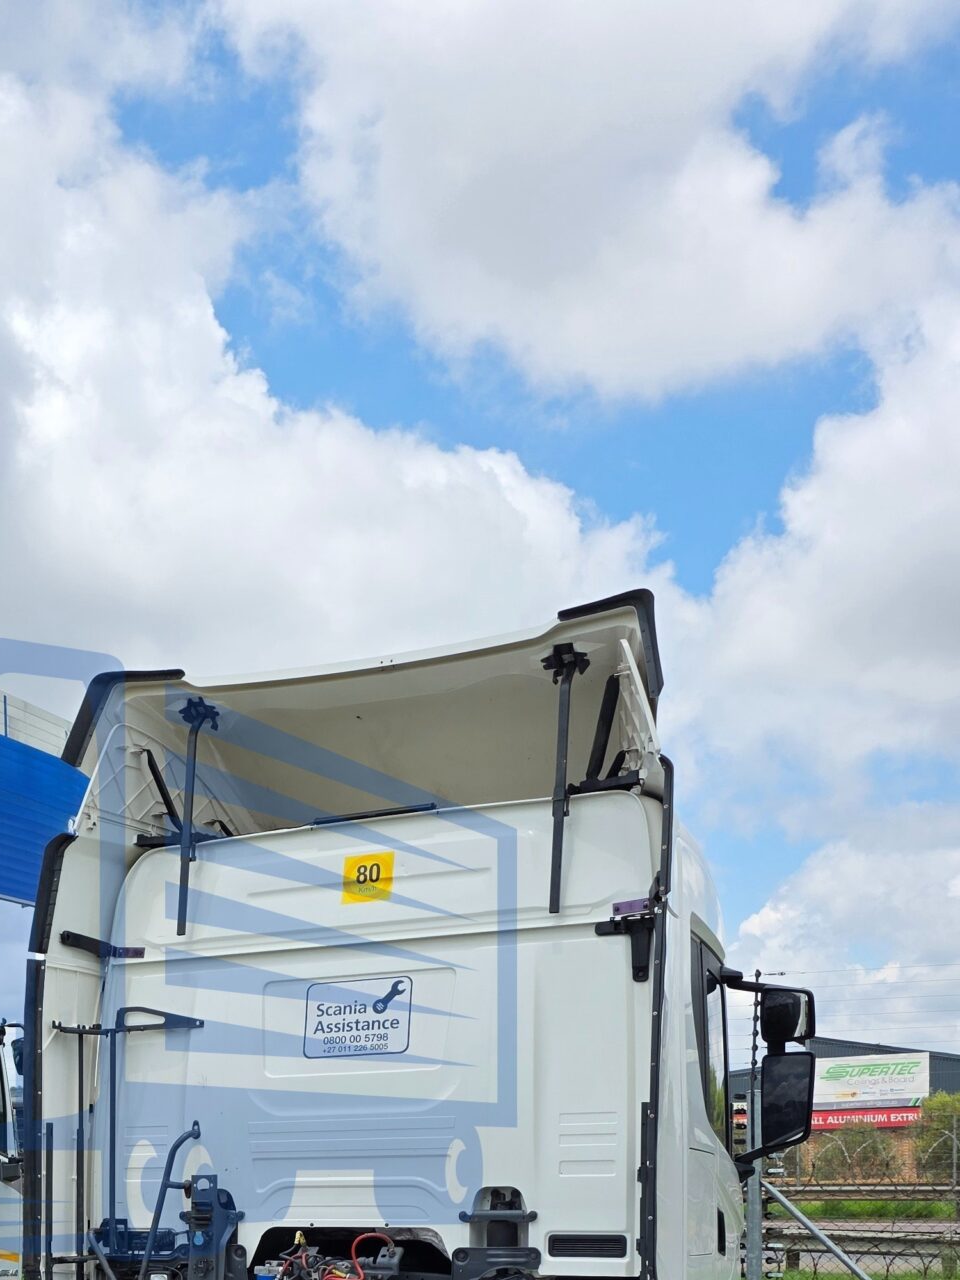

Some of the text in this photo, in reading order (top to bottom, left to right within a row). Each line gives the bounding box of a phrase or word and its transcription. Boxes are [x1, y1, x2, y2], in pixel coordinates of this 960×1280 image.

[356, 862, 380, 885] 80
[316, 1000, 367, 1017] Scania
[313, 1018, 400, 1035] Assistance
[323, 1033, 389, 1045] 0800 00 5798
[323, 1046, 336, 1054] +27
[338, 1045, 351, 1053] 011
